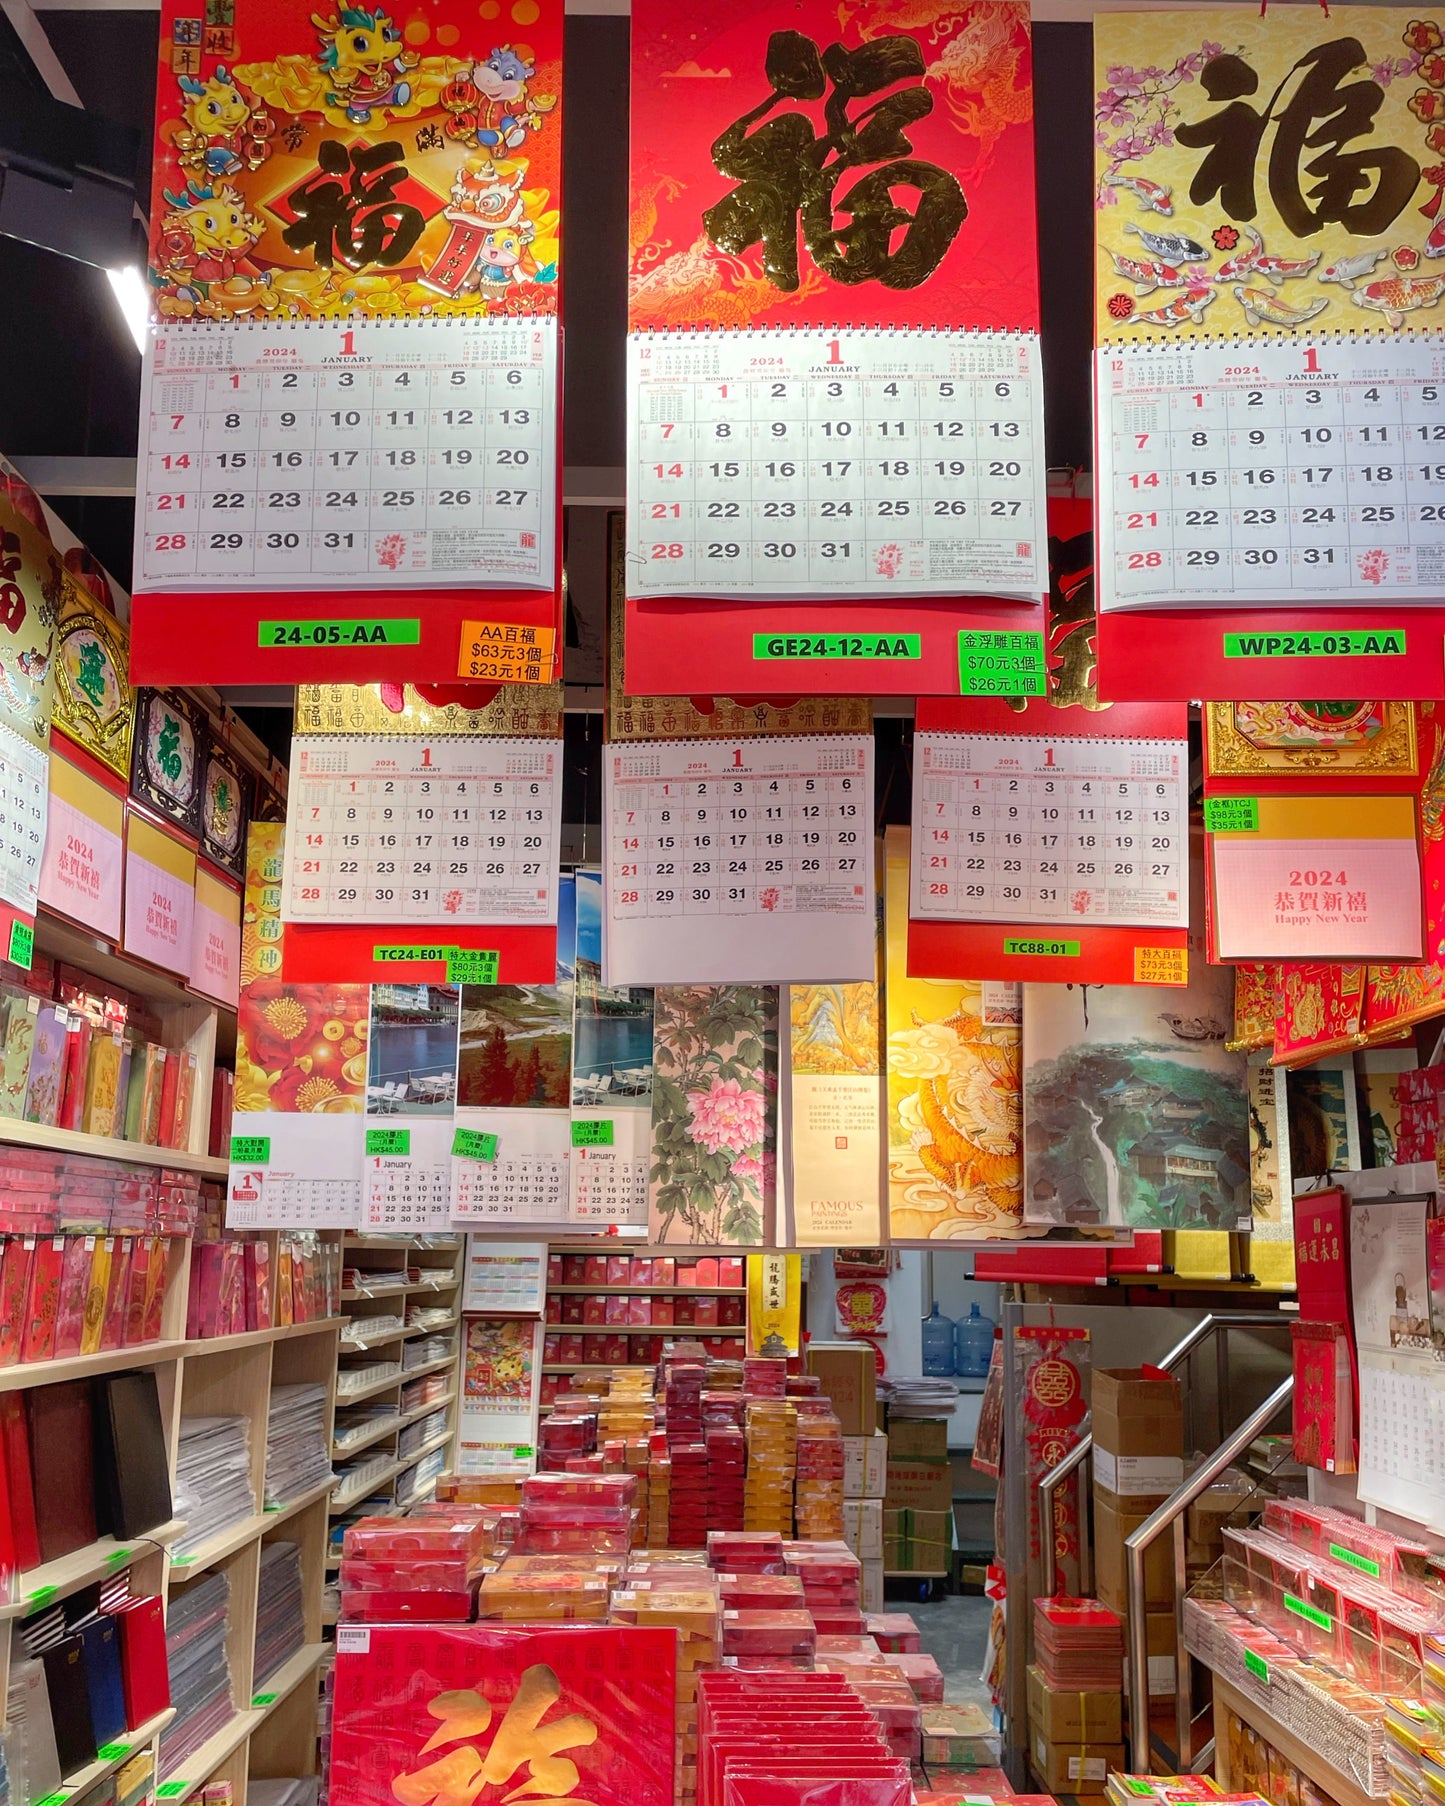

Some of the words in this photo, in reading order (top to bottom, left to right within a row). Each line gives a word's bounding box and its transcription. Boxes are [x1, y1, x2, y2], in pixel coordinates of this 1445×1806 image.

[1173, 36, 1421, 238] 福
[702, 30, 968, 292] 福
[282, 140, 425, 270] 福
[155, 339, 166, 350] 12
[339, 331, 357, 355] 1
[534, 332, 541, 343] 2
[263, 348, 297, 356] 2024
[640, 348, 651, 359] 12
[826, 340, 844, 365] 1
[1019, 347, 1026, 356] 2
[1302, 348, 1322, 373] 1
[750, 358, 784, 366] 2024
[1111, 360, 1124, 371] 12
[1225, 366, 1260, 375] 2024
[229, 374, 239, 388] 1
[282, 373, 297, 387] 2
[338, 372, 353, 386] 3
[395, 372, 410, 386] 4
[450, 371, 466, 386] 5
[506, 370, 523, 385] 6
[1286, 373, 1339, 381] JANUARY
[171, 415, 184, 429] 7
[225, 414, 240, 428] 8
[281, 412, 296, 427] 9
[330, 411, 360, 426] 10
[387, 411, 415, 426] 11
[443, 410, 473, 424] 12
[499, 410, 529, 424] 13
[157, 494, 185, 510] 21
[212, 493, 244, 508] 22
[269, 492, 301, 507] 23
[325, 492, 358, 507] 24
[383, 491, 415, 506] 25
[439, 490, 471, 505] 26
[496, 490, 528, 505] 27
[652, 504, 679, 518] 21
[708, 503, 740, 517] 22
[764, 503, 796, 517] 23
[821, 502, 853, 517] 24
[878, 501, 910, 516] 25
[934, 501, 966, 515] 26
[991, 501, 1021, 516] 27
[155, 534, 186, 551] 28
[210, 534, 243, 548] 29
[267, 533, 299, 548] 30
[324, 533, 353, 548] 31
[1128, 552, 1162, 569] 28
[1187, 550, 1220, 565] 29
[1244, 550, 1278, 564] 30
[1304, 548, 1333, 563] 31
[273, 626, 387, 645] 24-05-AA
[480, 626, 537, 644] AA百福
[963, 634, 1039, 650] 金浮雕百福
[471, 643, 542, 662] $63元3個
[767, 638, 910, 657] GE24-12-AA
[1239, 637, 1400, 655] WP24-03-AA
[470, 661, 540, 681] $23元1個
[968, 656, 1036, 671] $70元3個
[969, 677, 1037, 692] $26元1個
[420, 748, 433, 767] 1
[732, 749, 745, 767] 1
[1043, 748, 1056, 767] 1
[17, 773, 23, 783] 5
[33, 784, 40, 794] 6
[13, 797, 25, 810] 12
[31, 807, 41, 820] 13
[1210, 809, 1252, 819] $98元3個
[12, 821, 23, 834] 19
[29, 831, 40, 844] 20
[1211, 820, 1253, 830] $35元1個
[10, 845, 22, 858] 26
[26, 854, 36, 867] 27
[67, 835, 93, 862] 2024
[58, 850, 100, 891] 恭賀新禧
[1289, 871, 1348, 886] 2024
[57, 870, 75, 889] Happy
[76, 879, 87, 893] New
[152, 892, 172, 913] 2024
[1274, 891, 1368, 912] 恭賀新禧
[258, 858, 282, 969] 龍馬精神
[1275, 914, 1312, 926] Happy
[1316, 914, 1339, 923] New
[1343, 914, 1368, 923] Year
[146, 910, 178, 936] 恭賀新禧
[208, 932, 225, 949] 2024
[1009, 942, 1066, 954] TC88-01
[379, 949, 443, 961] TC24-E01
[1142, 949, 1182, 960] 特大百福
[1140, 960, 1183, 970] $73元3個
[1140, 971, 1183, 982] $27元1個
[455, 1148, 488, 1159] HK$45.00
[579, 1149, 587, 1160] 1
[589, 1152, 616, 1161] January
[374, 1157, 381, 1169] 1
[383, 1160, 413, 1169] January
[242, 1175, 252, 1189] 1
[811, 1200, 864, 1211] FAMOUS
